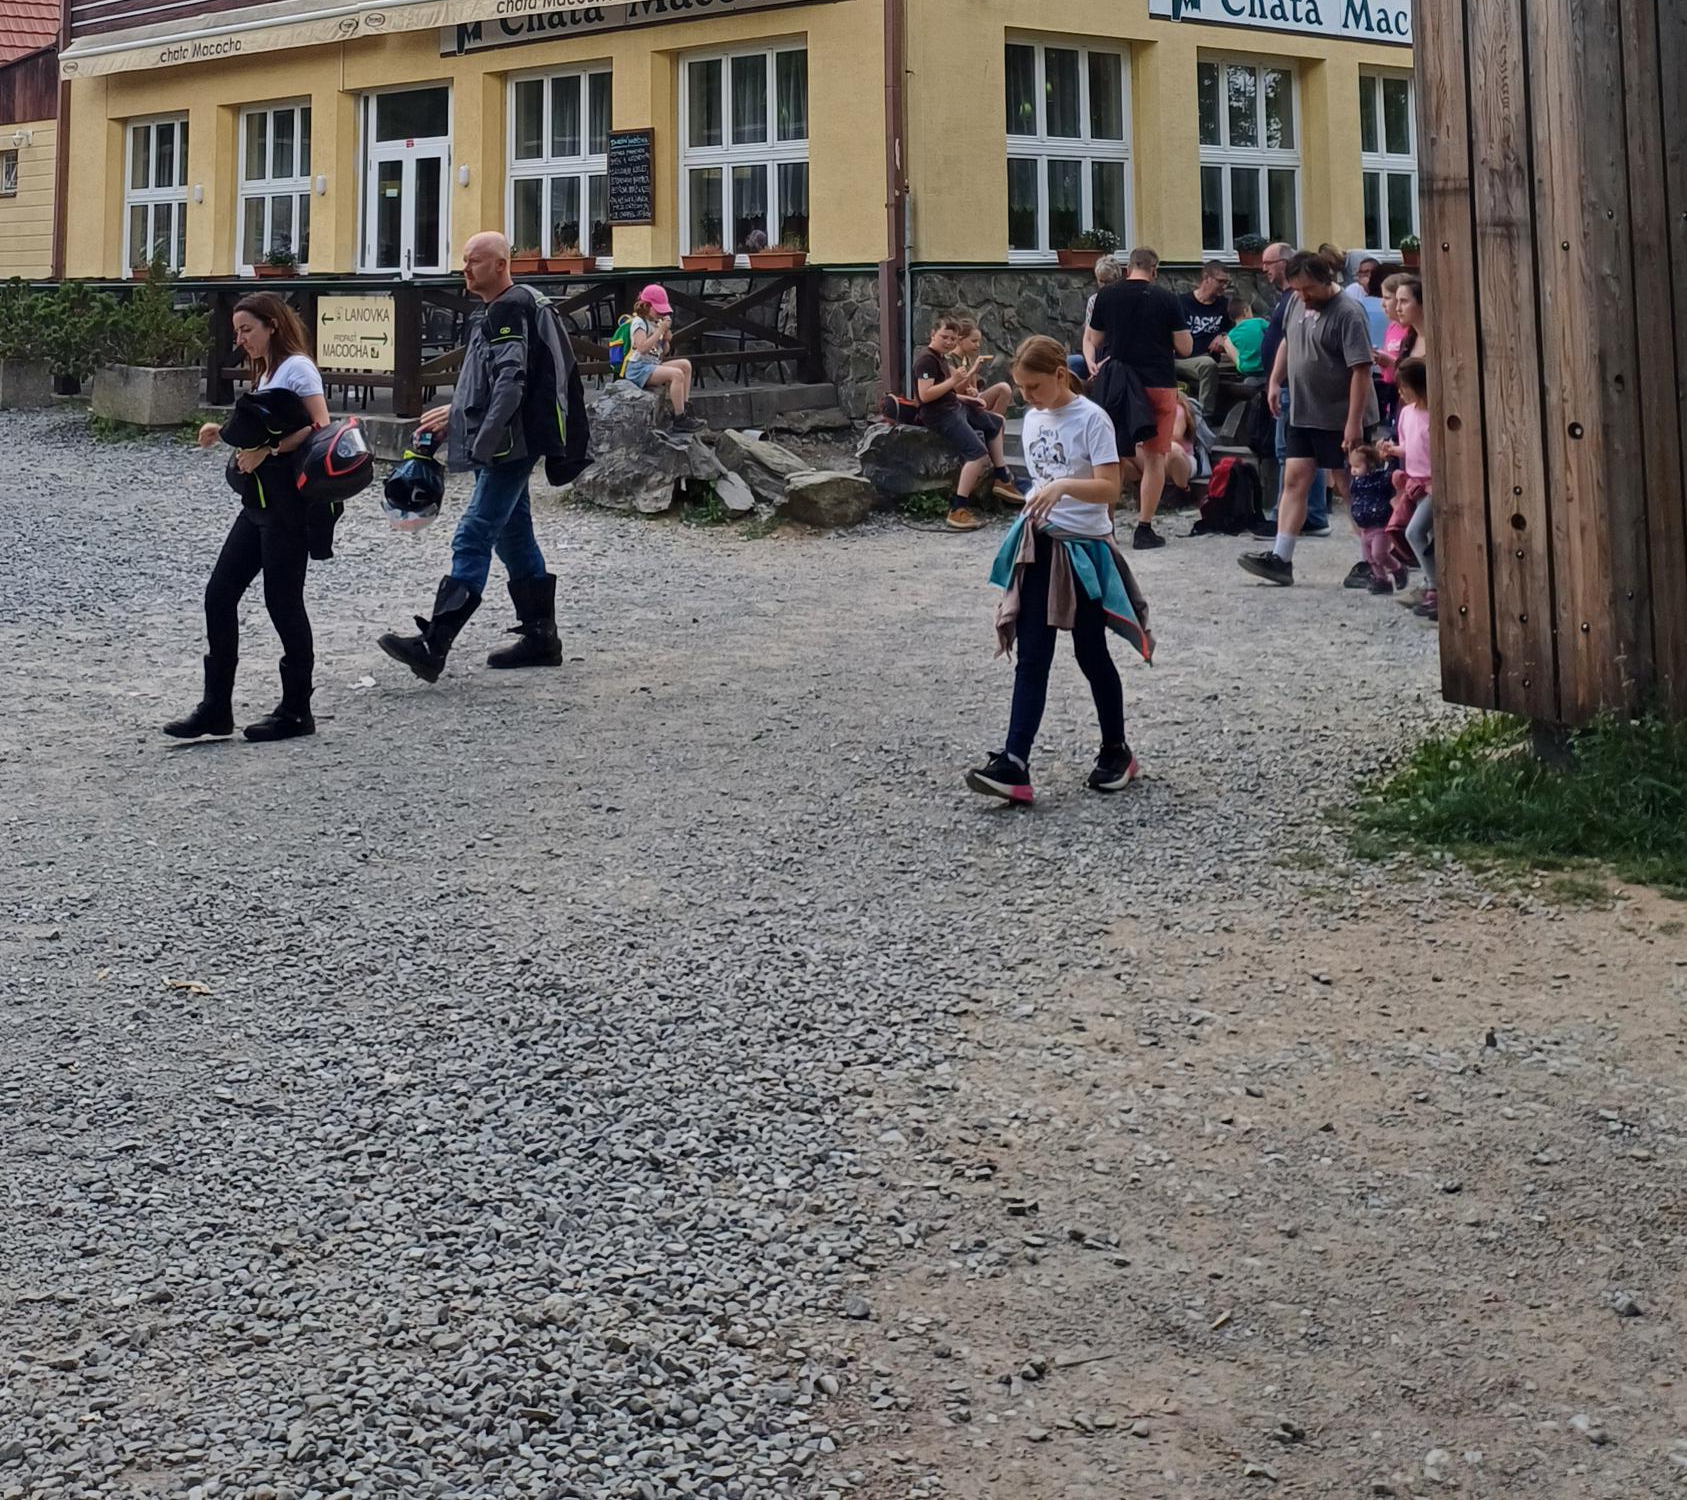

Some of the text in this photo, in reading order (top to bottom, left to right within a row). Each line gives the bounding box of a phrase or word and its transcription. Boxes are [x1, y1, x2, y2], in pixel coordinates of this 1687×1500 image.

[160, 37, 242, 63] chata Macocha
[345, 308, 390, 322] LANOVKA
[323, 344, 369, 358] MACOCHA
